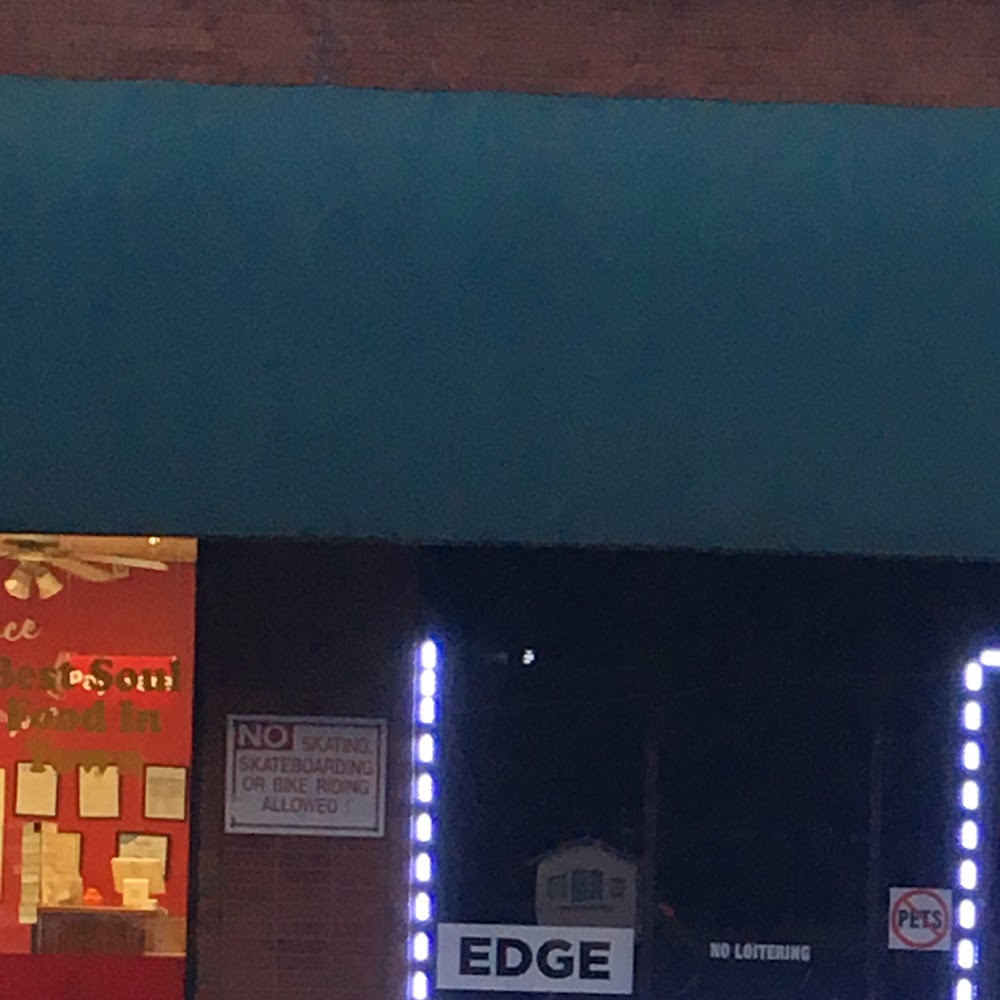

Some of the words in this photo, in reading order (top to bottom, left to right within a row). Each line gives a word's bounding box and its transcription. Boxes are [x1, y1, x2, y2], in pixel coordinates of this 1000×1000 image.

[237, 723, 289, 748] NO
[302, 736, 371, 754] SKATING
[239, 755, 374, 776] SKATEBOARDING
[242, 775, 265, 792] OR
[273, 776, 308, 794] BIKE
[316, 778, 370, 795] RIDING
[262, 795, 338, 814] ALLOWED
[898, 909, 942, 929] PETS
[459, 937, 611, 980] EDGE
[709, 941, 730, 959] NO
[734, 942, 811, 962] LOITERING
